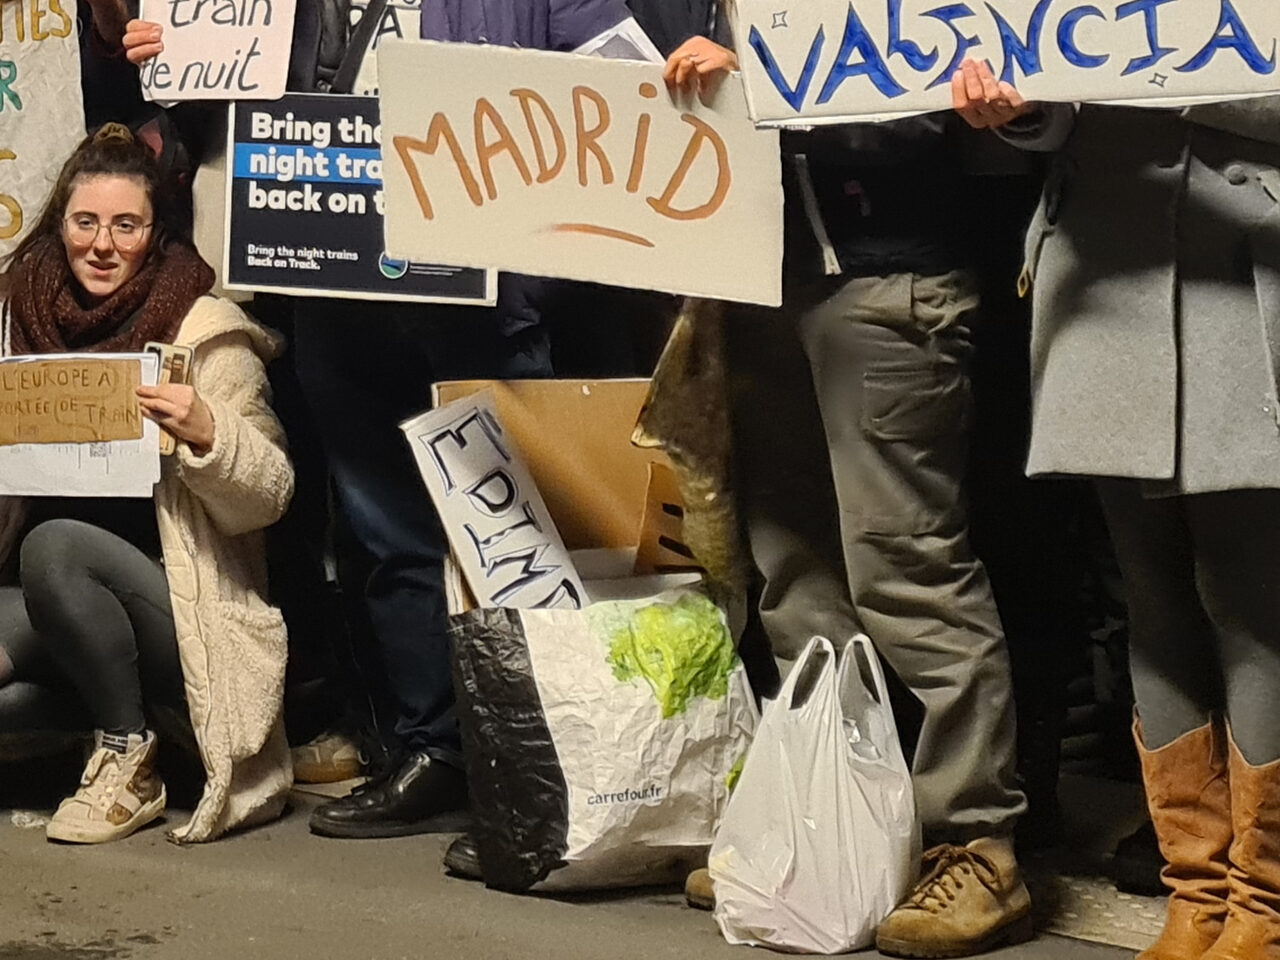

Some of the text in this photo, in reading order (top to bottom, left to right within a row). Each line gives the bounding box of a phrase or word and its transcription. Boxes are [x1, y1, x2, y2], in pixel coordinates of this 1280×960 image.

[178, 37, 260, 91] nuit
[250, 111, 331, 148] Bring
[249, 147, 384, 181] night tra
[248, 182, 322, 212] back
[328, 192, 366, 214] on
[247, 244, 359, 261] Bring the night trains
[247, 256, 321, 270] Back on Track.
[2, 367, 90, 391] L'EUROPE
[60, 397, 79, 412] DE
[587, 783, 662, 805] carrefour.fr
